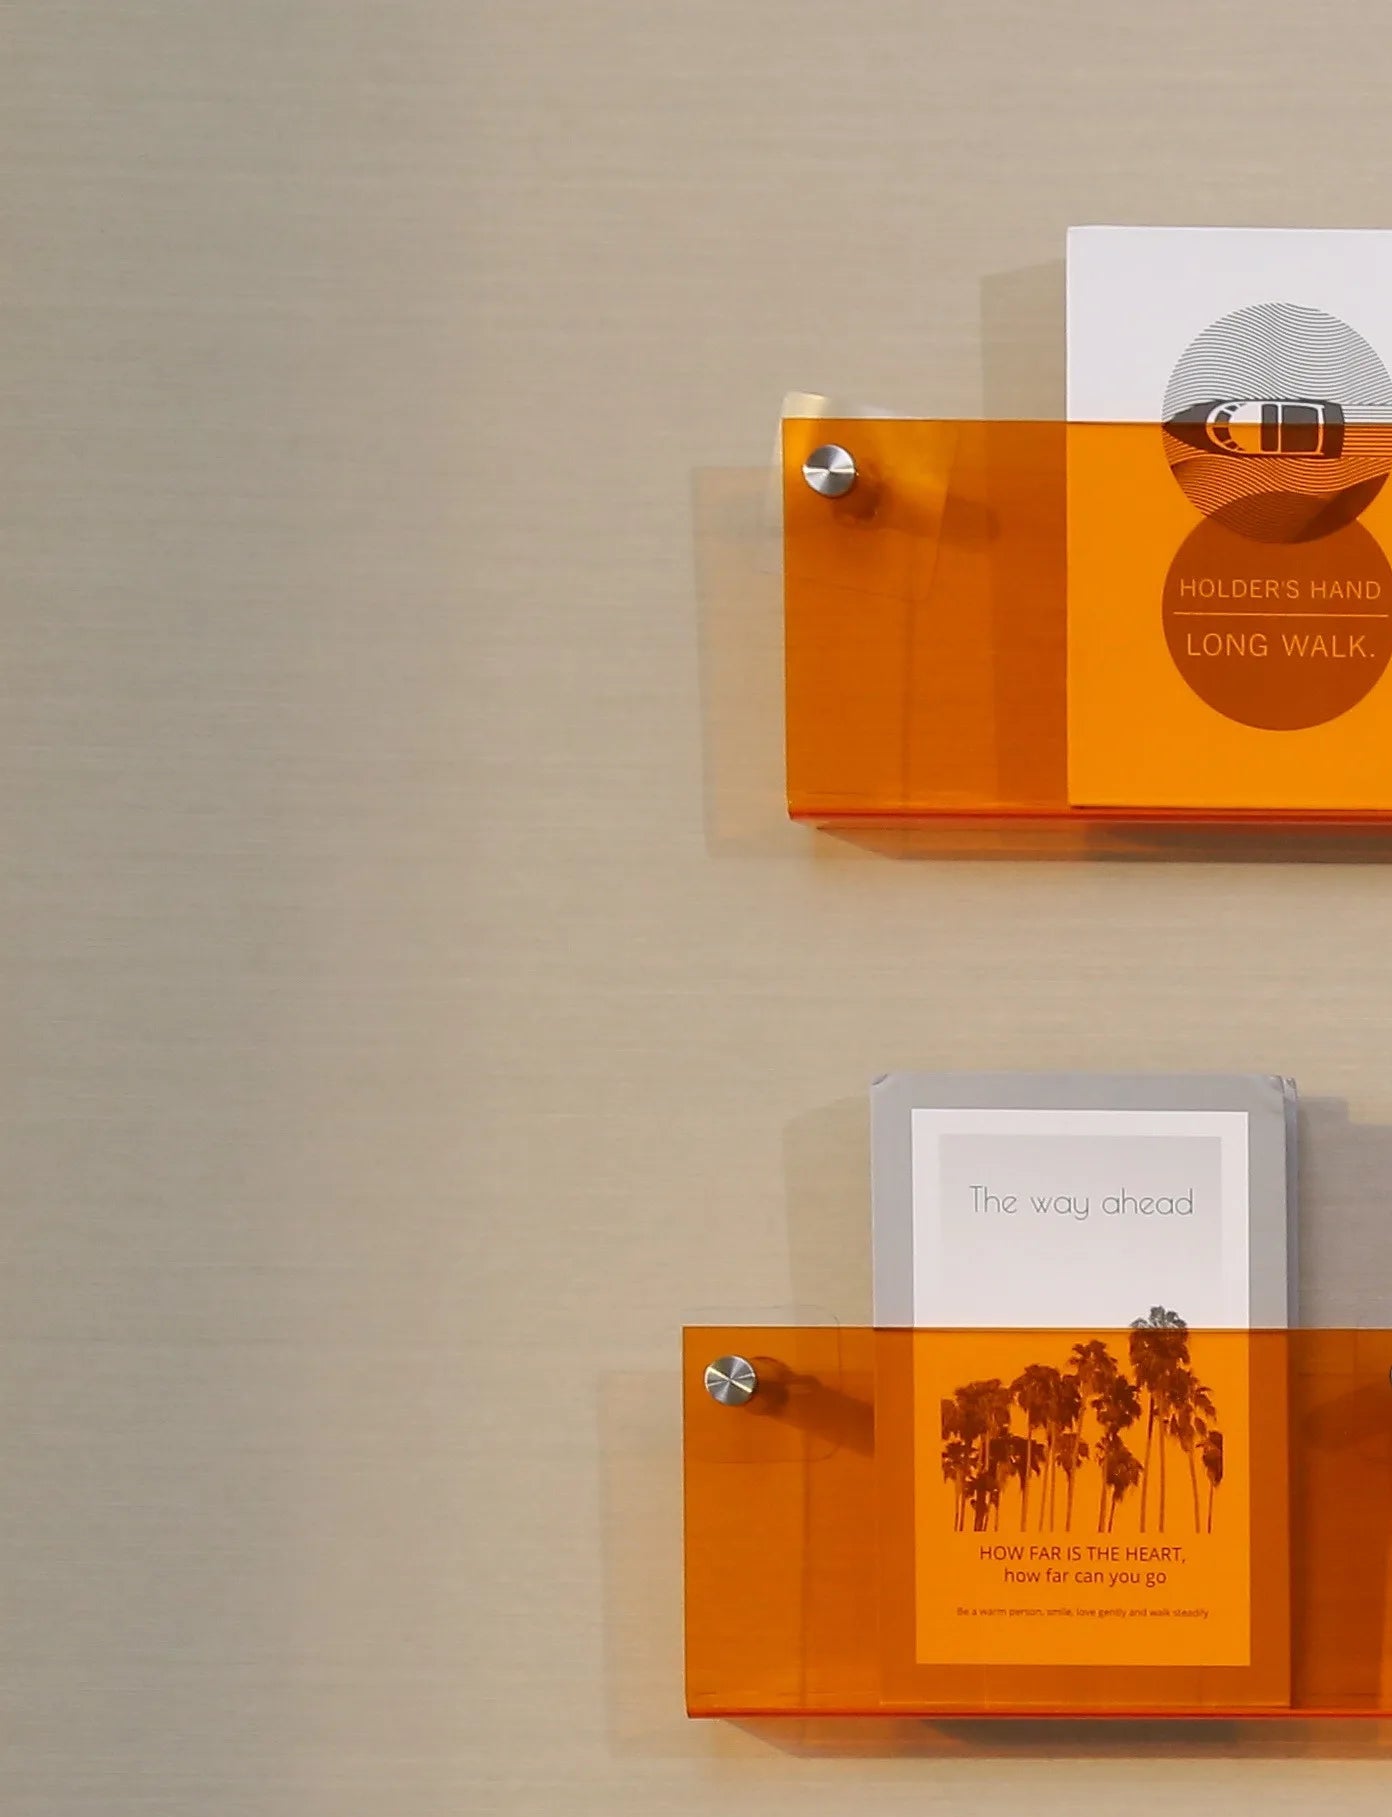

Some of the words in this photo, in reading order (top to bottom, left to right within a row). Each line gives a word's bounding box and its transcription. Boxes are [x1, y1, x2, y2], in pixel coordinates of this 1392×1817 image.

[1180, 578, 1300, 599] HOLDER'S
[1310, 580, 1381, 600] HAND
[1187, 633, 1268, 657] LONG
[1281, 634, 1375, 658] WALK.
[969, 1185, 1017, 1214] The
[1030, 1196, 1089, 1220] way
[1102, 1187, 1194, 1215] ahead
[980, 1546, 1024, 1560] HOW
[1030, 1546, 1061, 1560] FAR
[1067, 1547, 1081, 1561] IS
[1087, 1547, 1120, 1561] THE
[1126, 1547, 1186, 1563] HEART,
[1004, 1568, 1040, 1583] how
[1046, 1568, 1069, 1583] far
[1075, 1571, 1104, 1583] can
[1109, 1572, 1140, 1587] you
[1146, 1572, 1167, 1587] go
